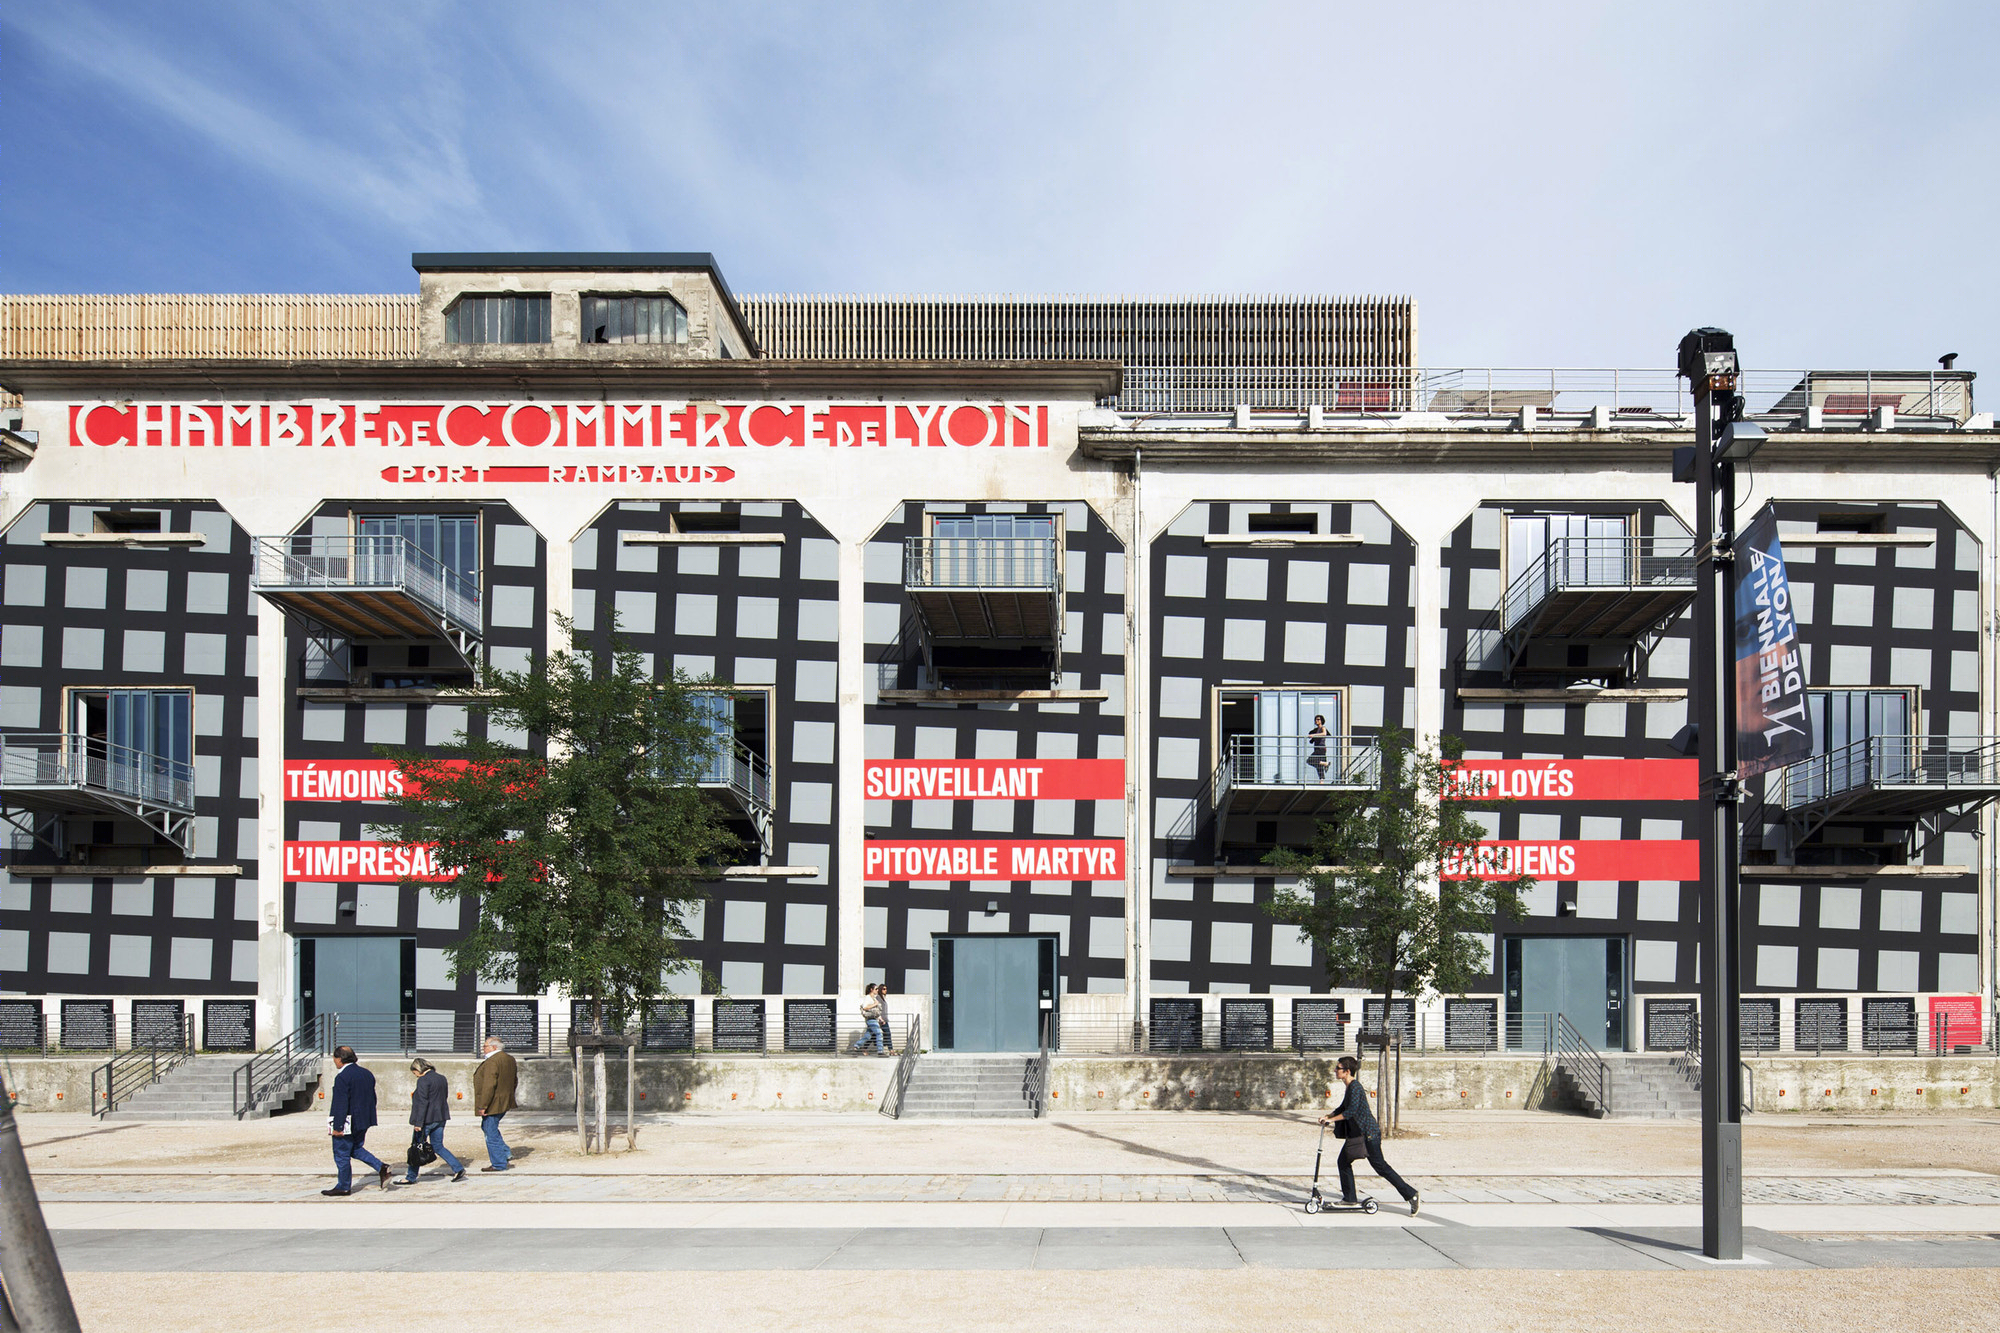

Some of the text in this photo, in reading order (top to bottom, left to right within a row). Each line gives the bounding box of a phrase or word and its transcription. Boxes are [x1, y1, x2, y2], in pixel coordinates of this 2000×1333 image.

[75, 404, 1039, 446] CHAMBRE DE COMMERCE DE LYON
[398, 466, 718, 482] PORT RAMBAUD
[1751, 551, 1781, 703] BIENNALE
[1768, 559, 1801, 694] DE LYON
[286, 762, 404, 798] TÉMOINS
[867, 766, 1043, 797] SURVEILLANT
[1442, 763, 1574, 797] EMPLOYÉS
[866, 846, 1116, 875] PITOYABLE MARTYR
